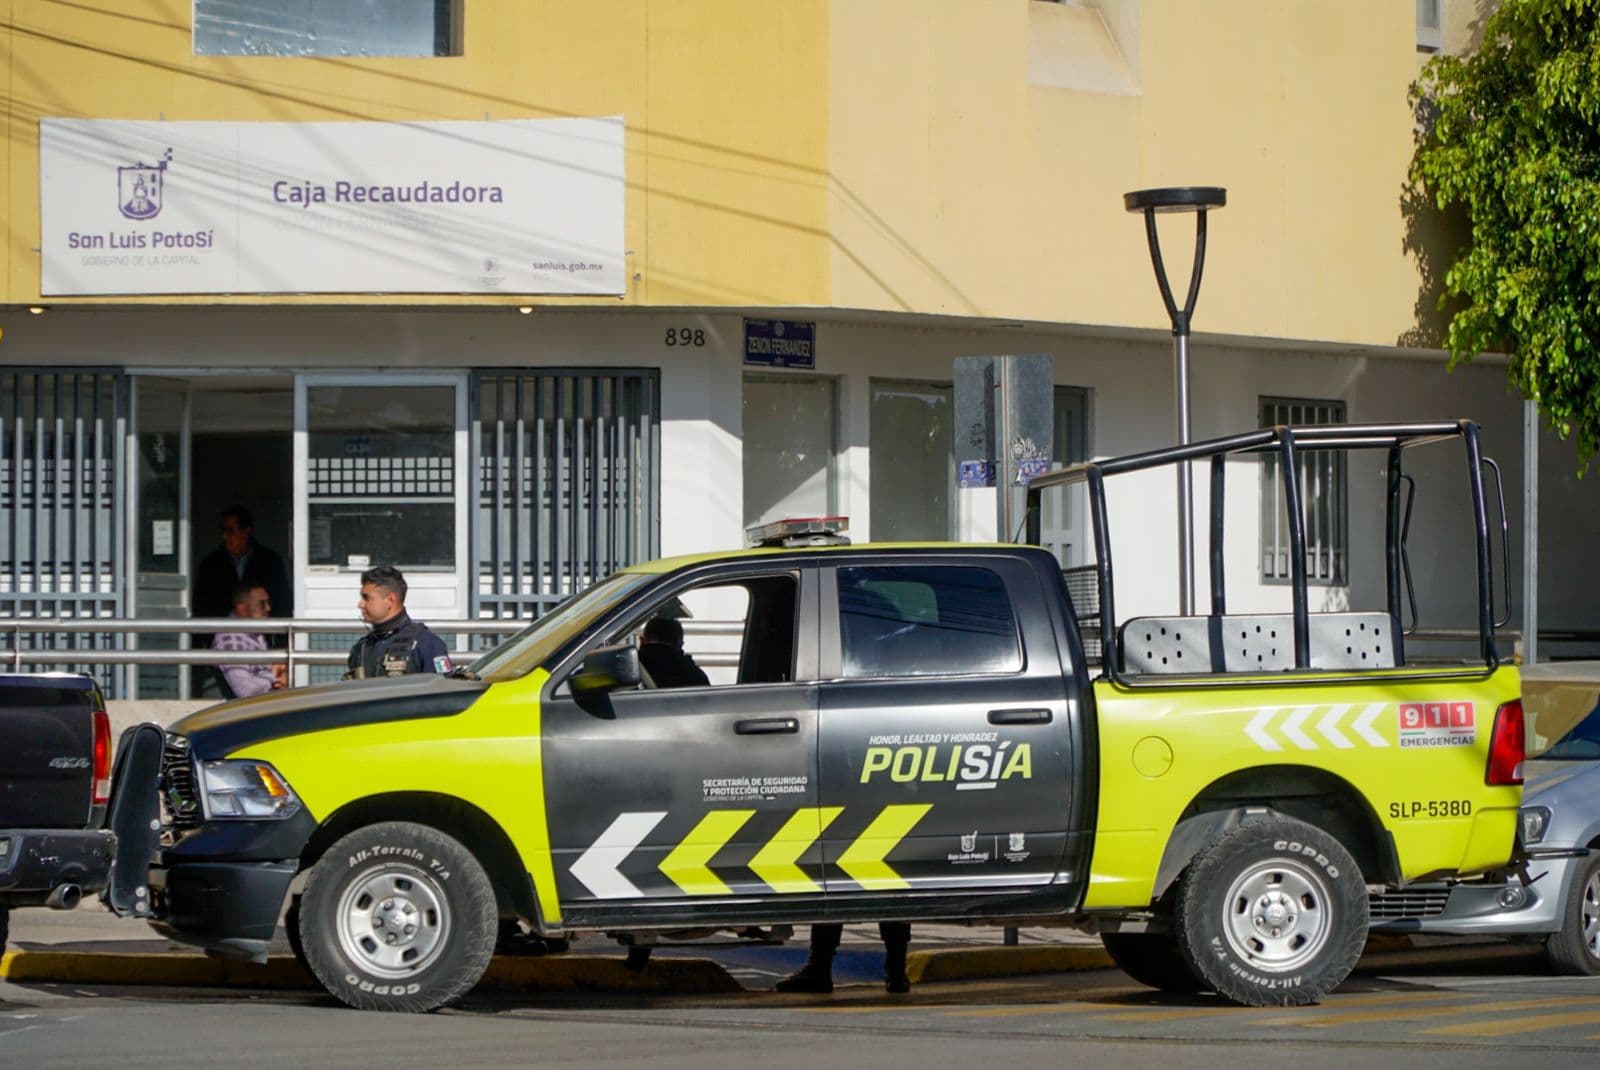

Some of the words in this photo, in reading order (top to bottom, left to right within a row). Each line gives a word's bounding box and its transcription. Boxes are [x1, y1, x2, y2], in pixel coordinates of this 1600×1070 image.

[273, 181, 326, 208] Caja
[335, 181, 503, 203] Recaudadora
[68, 231, 104, 249] San
[109, 230, 147, 249] Luis
[81, 255, 129, 266] GOBIERNO
[131, 255, 145, 265] DE
[147, 255, 160, 265] LA
[162, 255, 201, 265] CAPITAL
[532, 261, 603, 272] sanluis.gob.mx
[665, 328, 705, 346] 898
[1405, 704, 1467, 727] 911
[903, 734, 942, 744] LEALTAD
[943, 733, 951, 743] Y
[951, 732, 998, 743] HONRADEZ
[1401, 736, 1475, 747] EMERGENCIAS
[751, 778, 762, 786] DE
[763, 776, 808, 786] SEGURIDAD
[703, 787, 709, 796] Y
[760, 785, 805, 794] CIUDADANA
[1390, 800, 1472, 818] SLP-5380
[349, 845, 425, 868] All-Terrain
[429, 859, 451, 880] T/A
